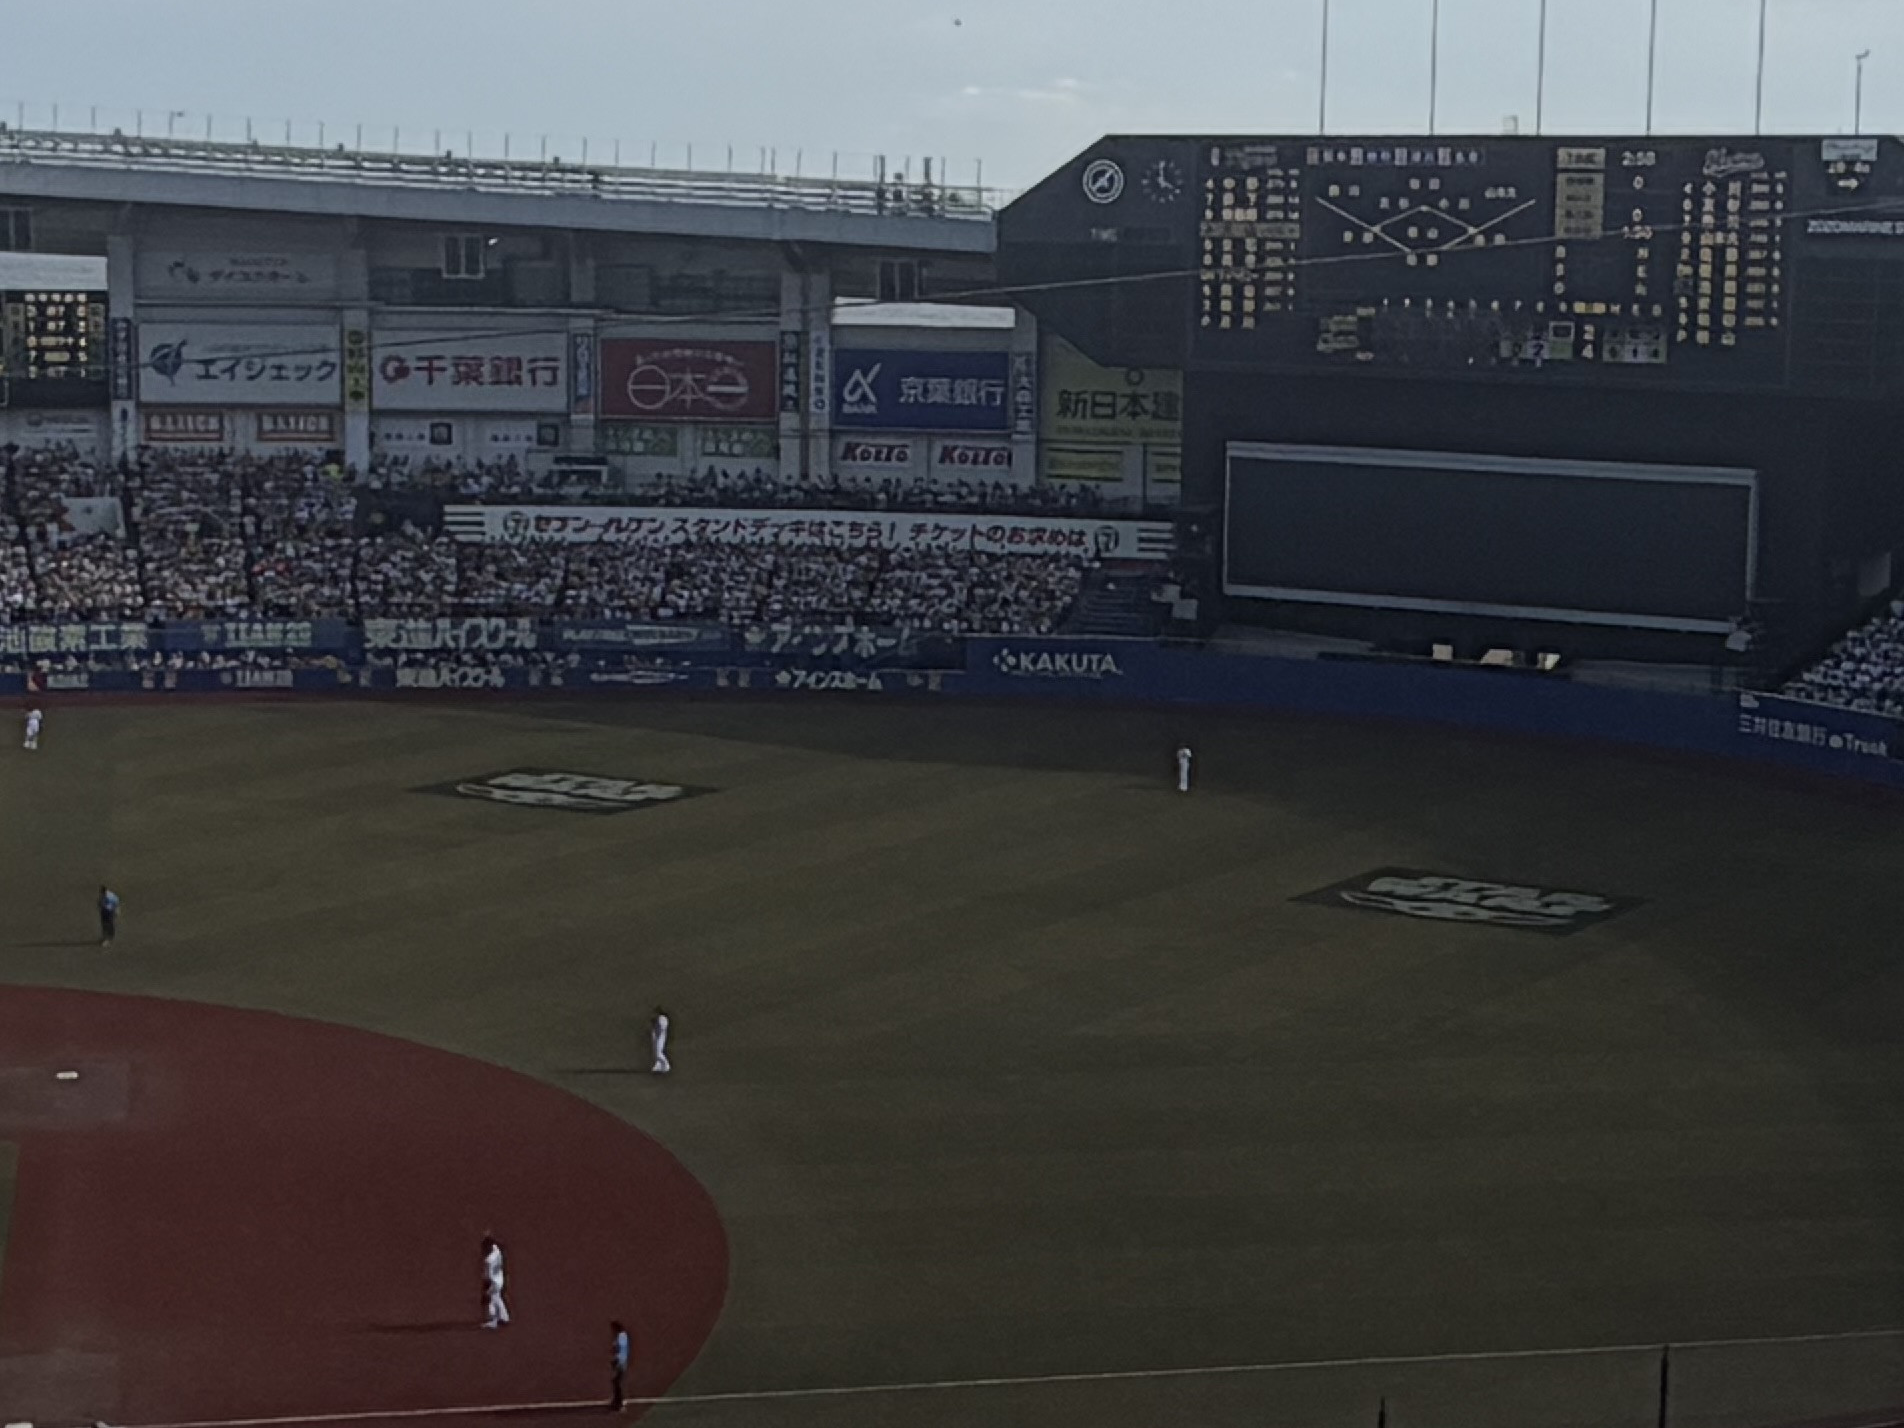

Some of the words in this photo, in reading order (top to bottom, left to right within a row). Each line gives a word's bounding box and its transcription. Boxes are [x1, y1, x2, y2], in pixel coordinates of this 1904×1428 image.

[414, 355, 562, 387] 千葉銀行
[898, 376, 1006, 407] 京葉銀行
[363, 618, 537, 649] 東進ハイスクール
[1020, 652, 1116, 672] KAKUTA
